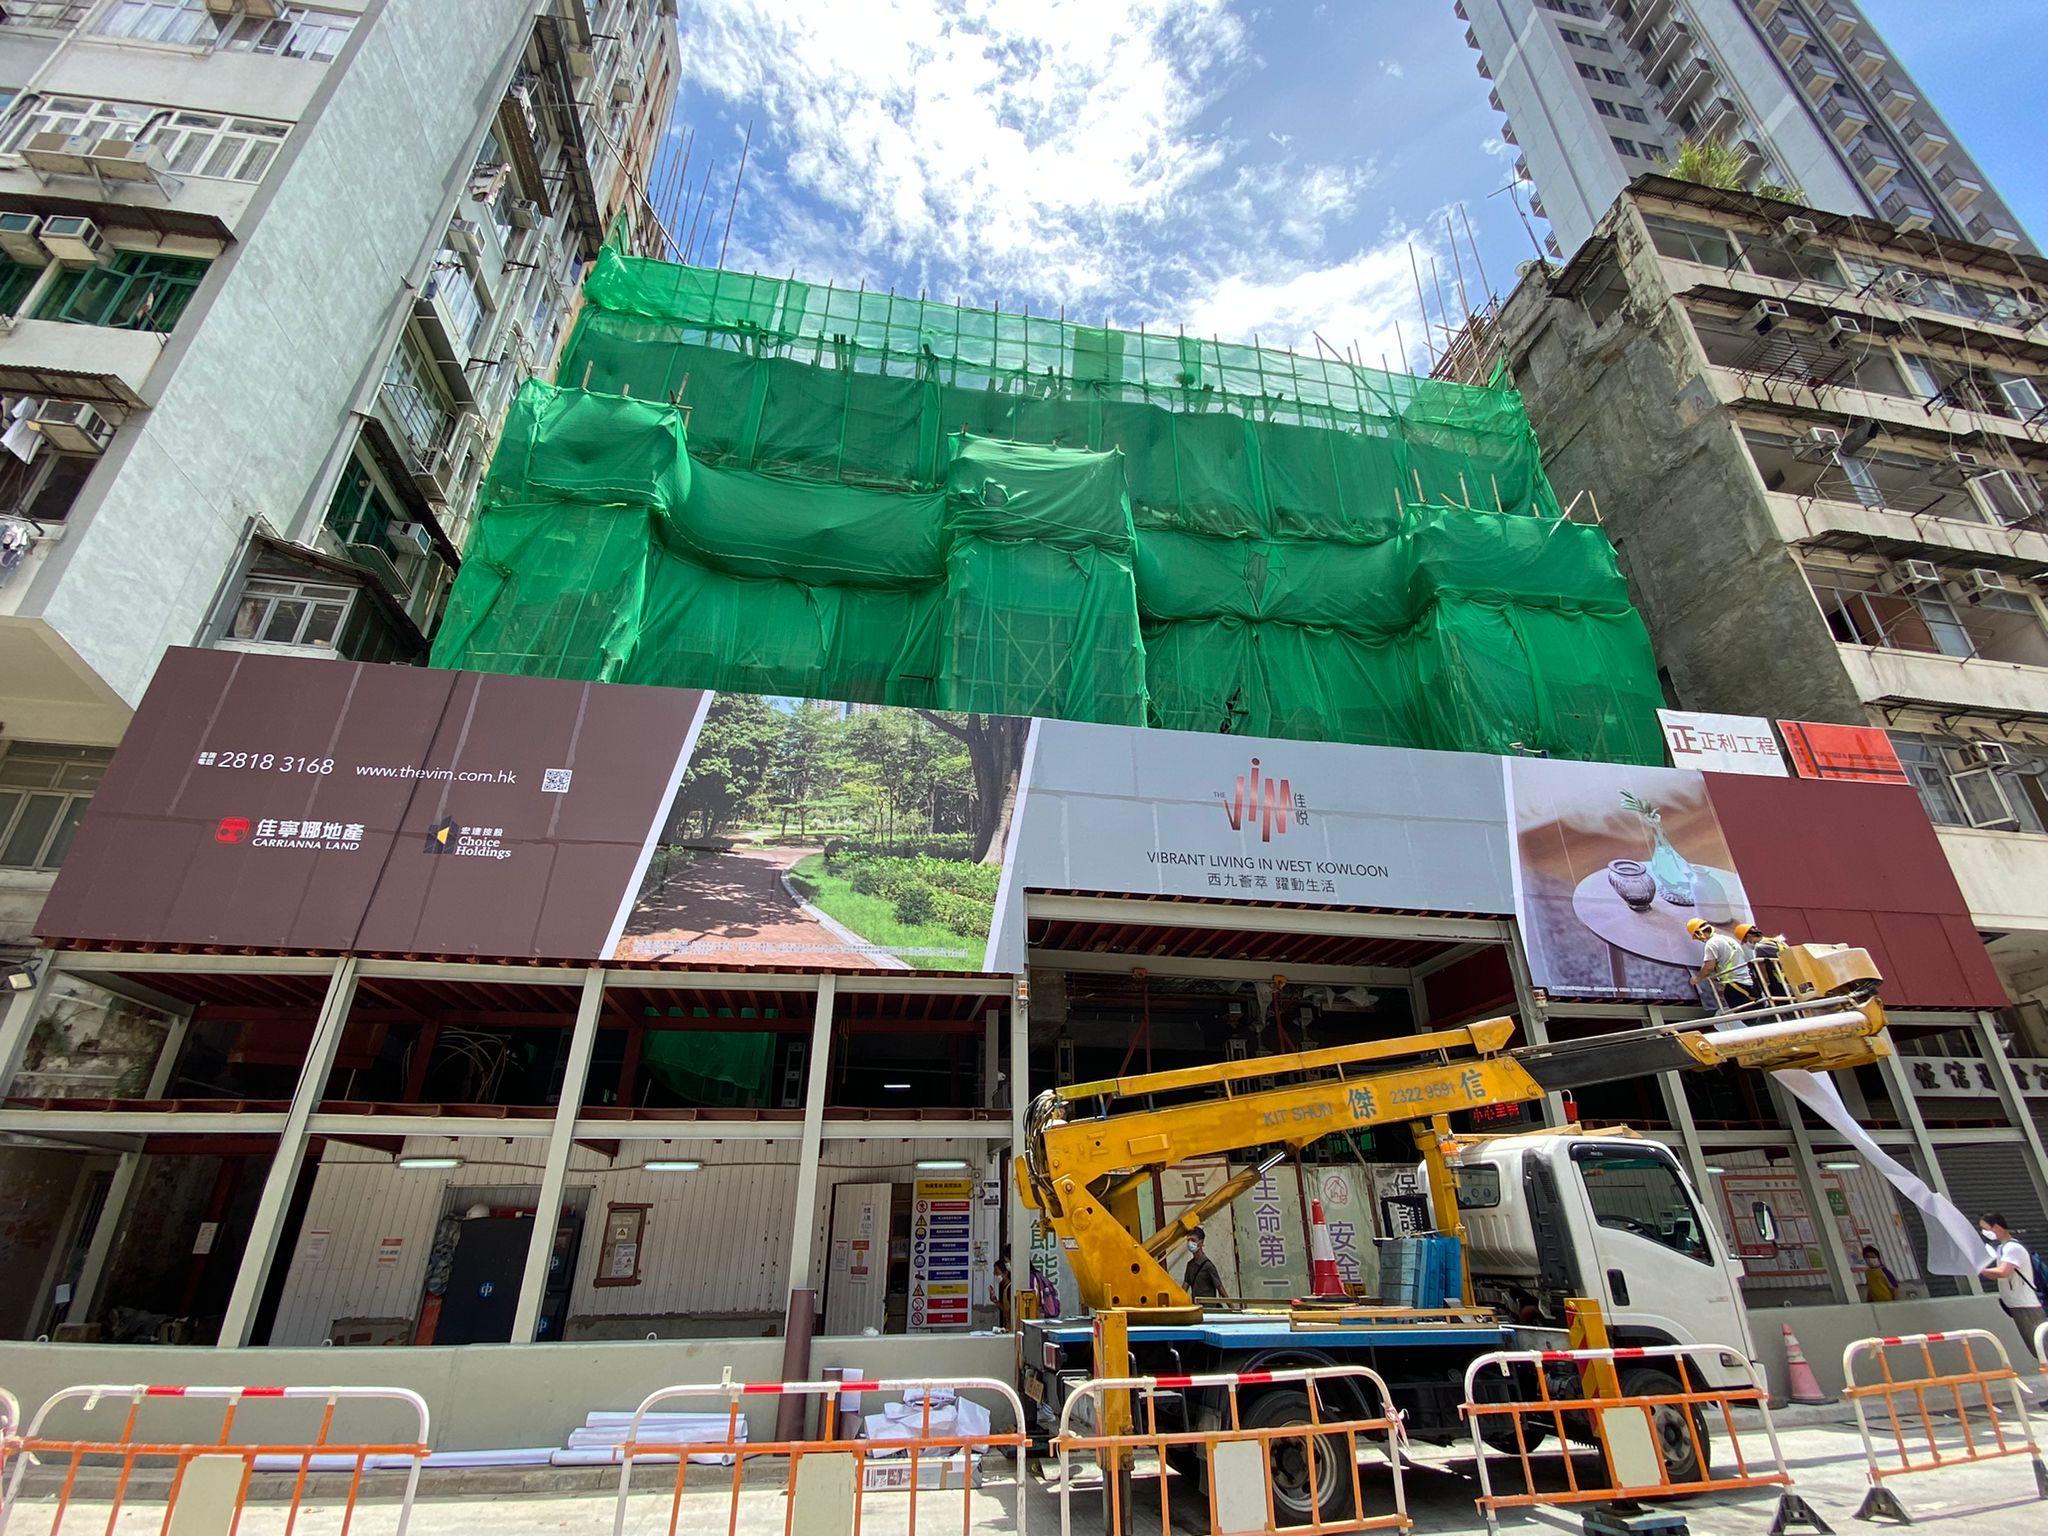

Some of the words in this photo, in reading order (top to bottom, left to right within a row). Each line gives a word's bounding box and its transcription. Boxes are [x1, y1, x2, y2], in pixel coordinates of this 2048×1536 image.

[1697, 731, 1779, 756] 正利工程
[217, 751, 275, 770] 2818
[279, 756, 335, 775] 3168
[356, 764, 517, 784] www.thevim.com.hk
[1213, 791, 1227, 799] THE
[255, 818, 365, 841] 佳寧娜地產
[458, 835, 501, 848] Choice
[252, 838, 322, 849] CARRIANNA
[325, 841, 360, 851] LAND
[455, 845, 512, 860] Holdings
[1146, 851, 1206, 866] VIBRANT
[1209, 855, 1255, 870] LIVING
[1258, 858, 1273, 871] IN
[1275, 859, 1312, 873] WEST
[1316, 862, 1389, 878] KOWLOON
[1207, 872, 1268, 889] 西九薈萃
[1275, 876, 1335, 893] 躍動生活
[1460, 1068, 1487, 1101] 信
[1263, 1109, 1287, 1127] KIT
[1390, 1087, 1424, 1105] 2322
[1424, 1081, 1456, 1099] 9591
[1181, 1172, 1206, 1199] 正
[1253, 1172, 1290, 1287] 生命第一
[1328, 1220, 1364, 1284] 安全
